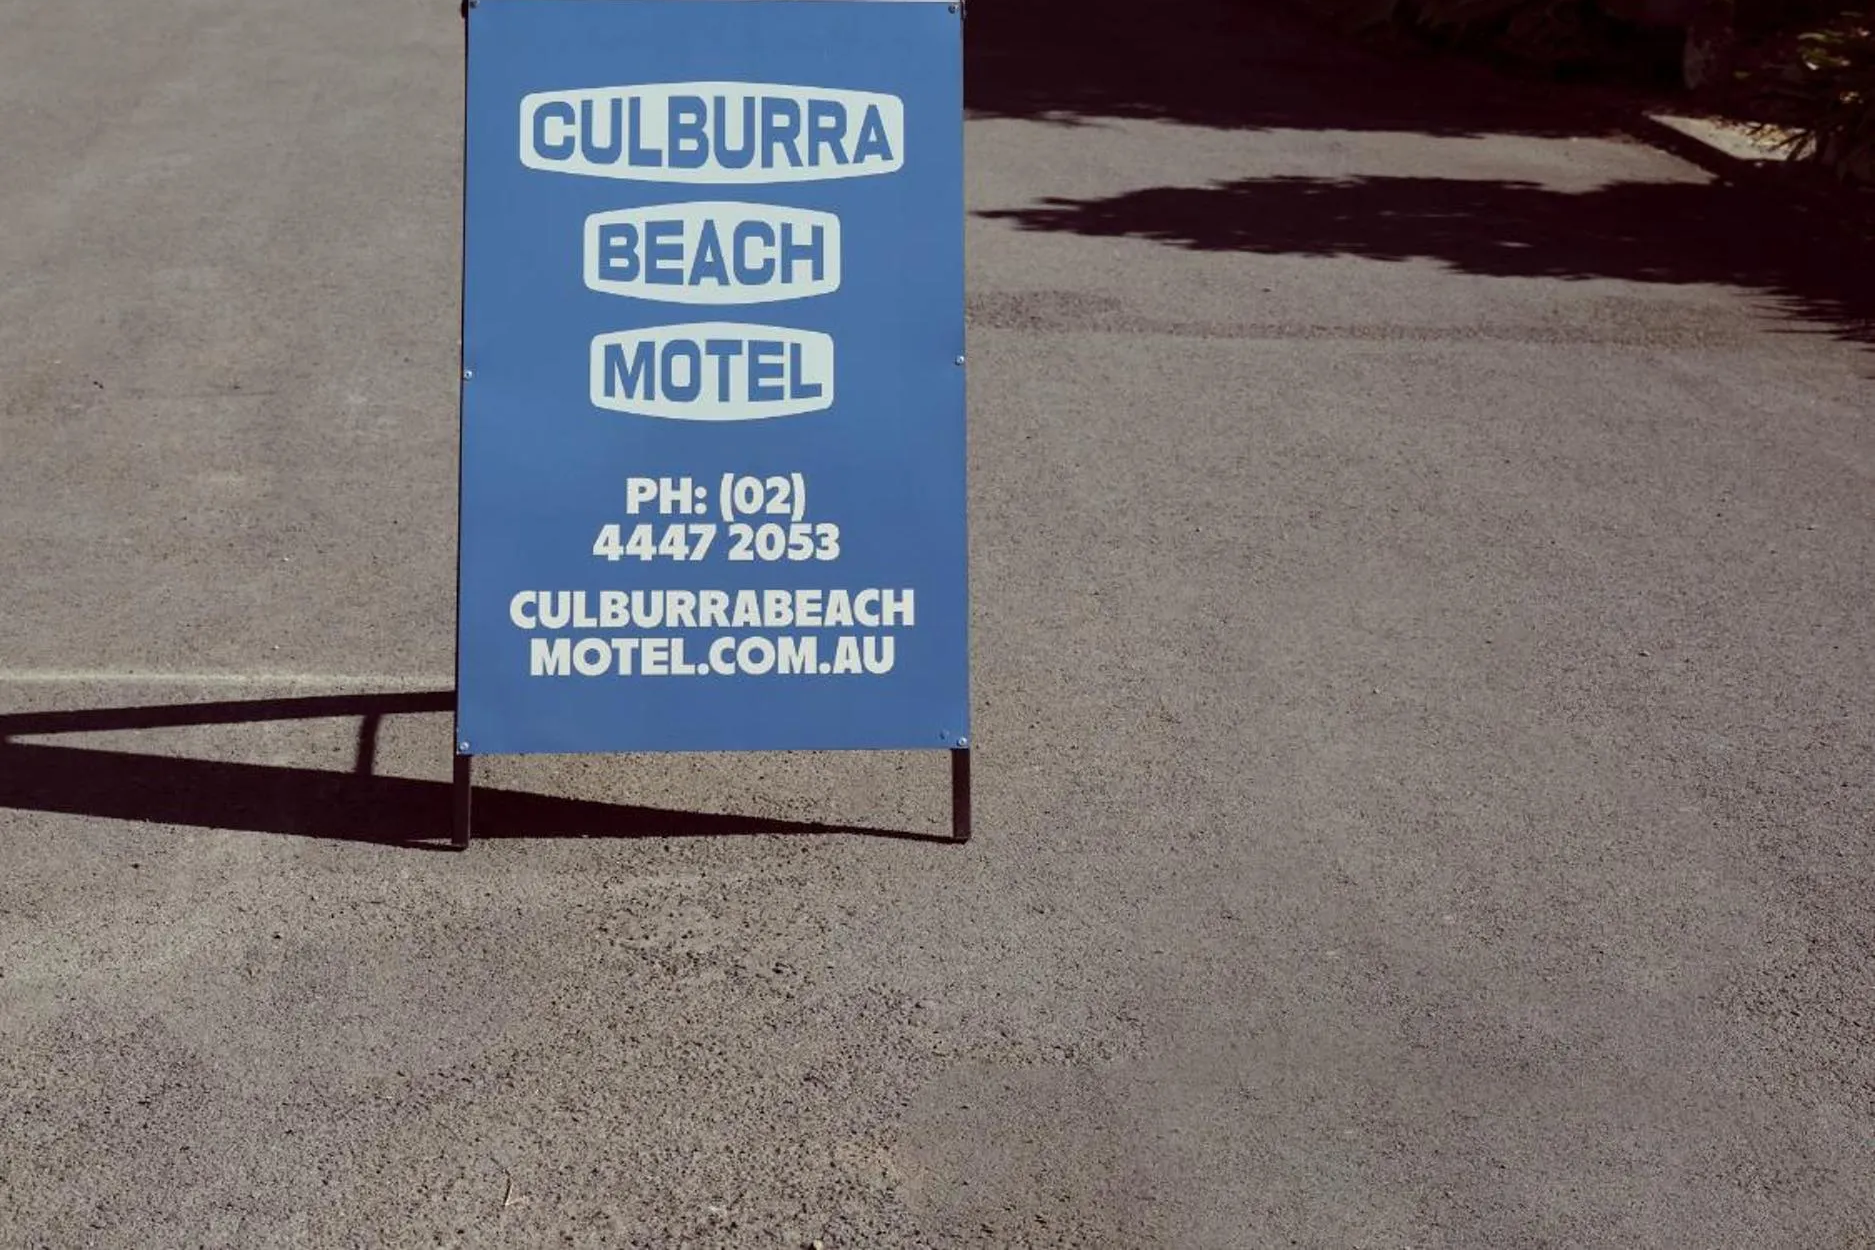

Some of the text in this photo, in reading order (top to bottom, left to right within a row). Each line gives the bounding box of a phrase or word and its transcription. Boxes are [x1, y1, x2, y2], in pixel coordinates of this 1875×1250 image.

[532, 94, 894, 170] CULBURRA
[598, 219, 825, 287] BEACH
[603, 339, 823, 404] MOTEL
[626, 472, 806, 522] PH: (02)
[592, 523, 841, 561] 4447 2053
[509, 588, 916, 630] CULBURRABEACH
[530, 636, 896, 676] MOTEL.COM.AU
